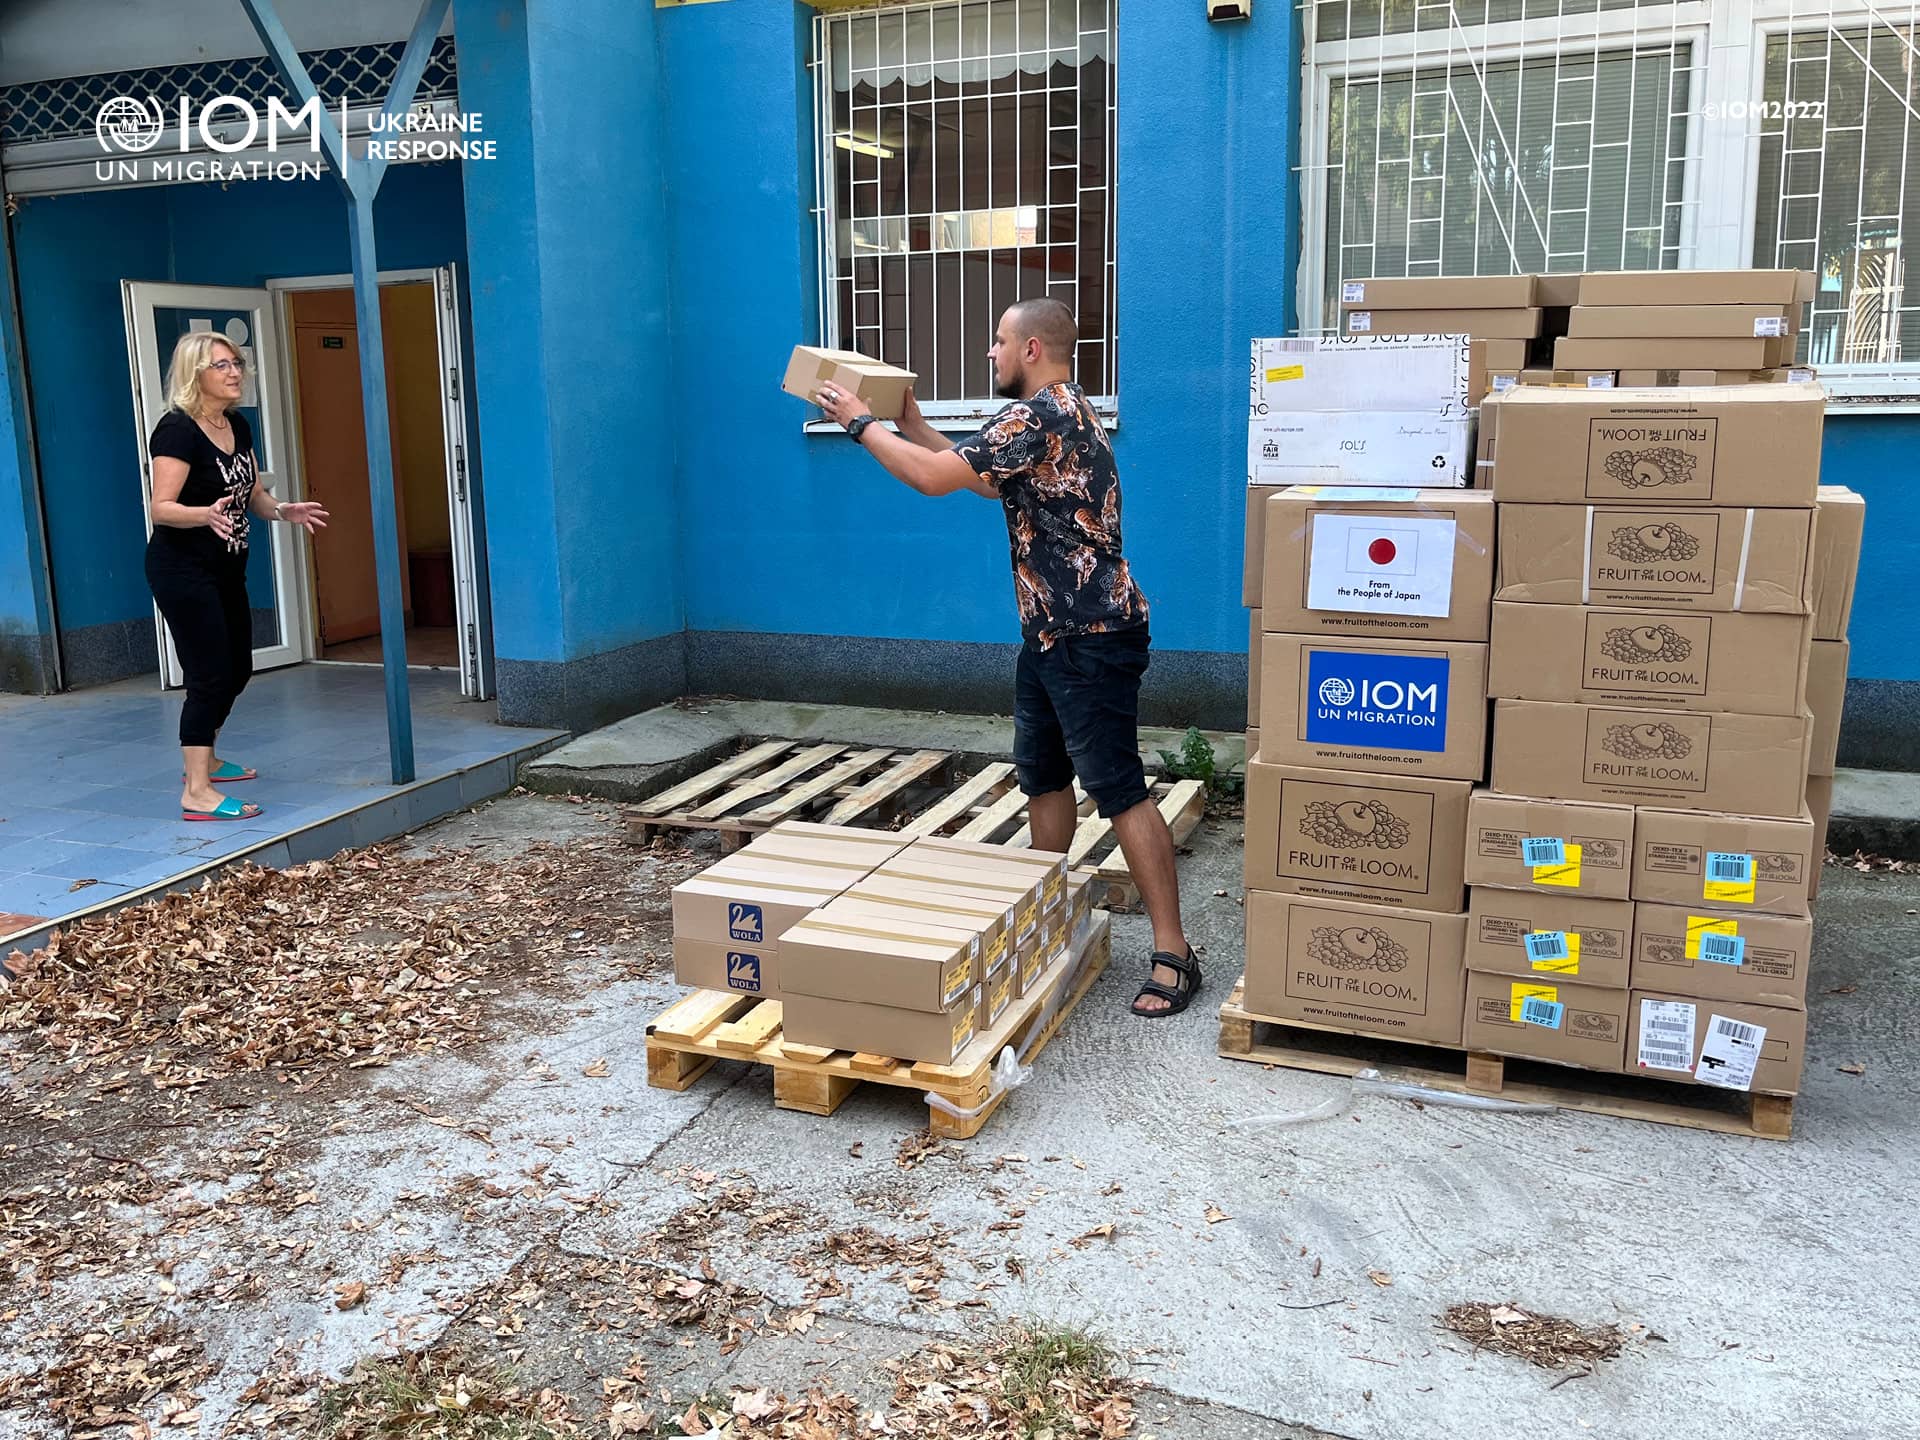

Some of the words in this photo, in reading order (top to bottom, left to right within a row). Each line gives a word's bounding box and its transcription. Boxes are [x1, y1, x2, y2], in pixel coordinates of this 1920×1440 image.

[1662, 428, 1707, 441] FRUIT
[1598, 568, 1640, 581] FRUIT
[1369, 580, 1390, 589] From
[1338, 587, 1351, 596] the
[1353, 588, 1382, 599] People
[1384, 590, 1393, 598] of
[1394, 591, 1420, 602] Japan
[1321, 617, 1429, 630] www.fruitoftheloom.com
[1592, 668, 1634, 681] FRUIT
[1362, 680, 1438, 712] IOM
[1318, 708, 1340, 720] UN
[1347, 710, 1436, 726] MIGRATION
[1316, 750, 1422, 764] www.fruitoftheloom.com
[1594, 763, 1634, 776] FRUIT
[1289, 851, 1340, 870] FRUIT
[1343, 856, 1356, 864] OF
[1340, 863, 1357, 872] THE
[732, 930, 760, 941] WOLA
[730, 979, 758, 990] WOLA
[1296, 972, 1344, 990] FRUIT
[1344, 984, 1360, 992] THE
[1303, 1006, 1406, 1027] www.fruitoftheloom.com
